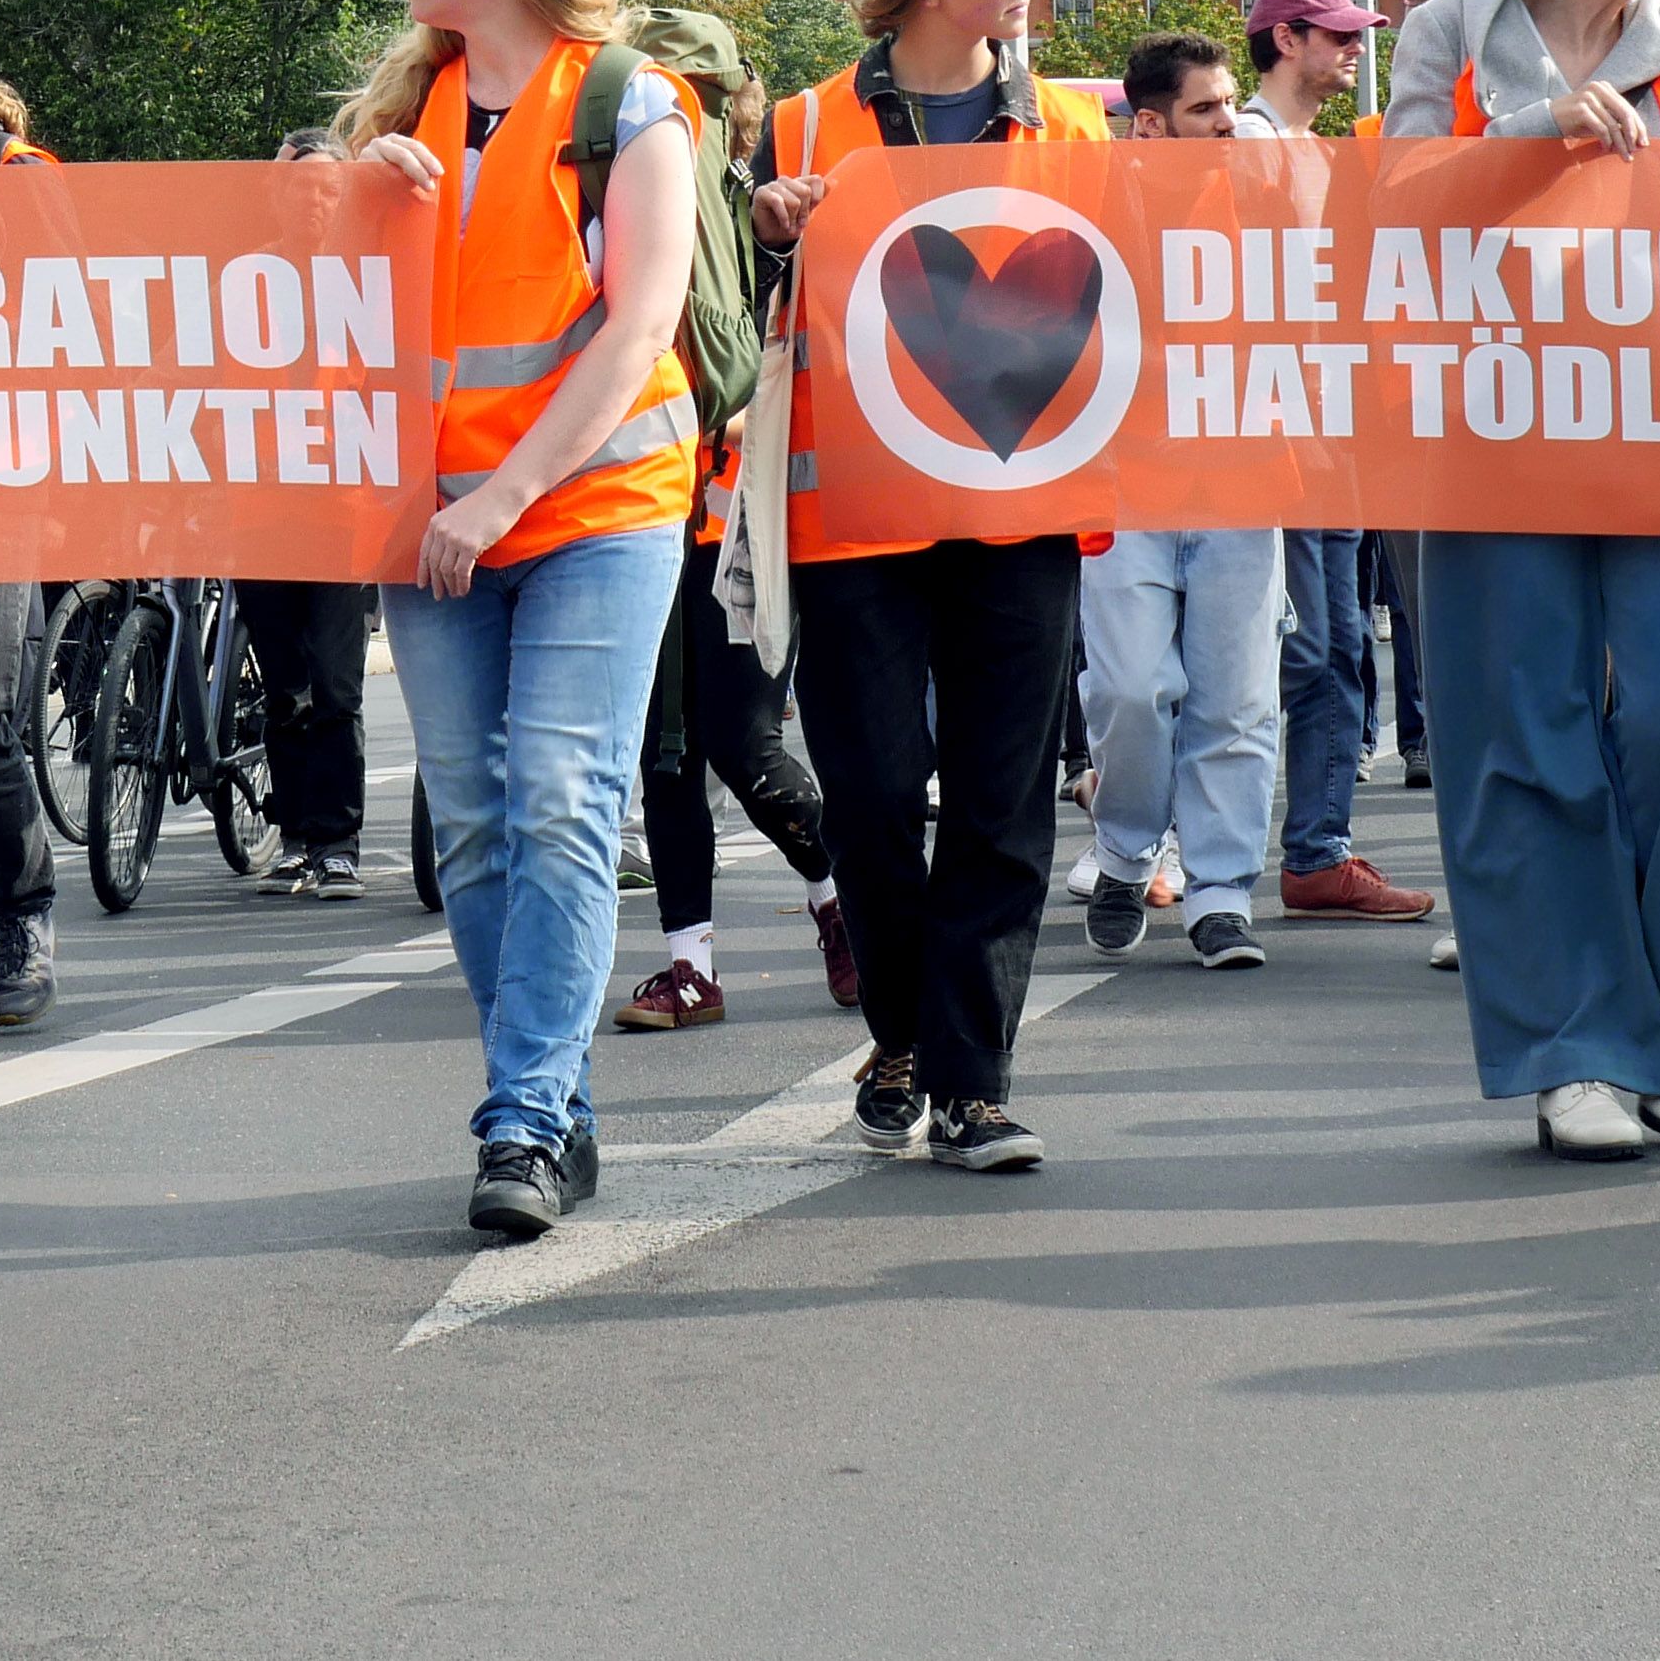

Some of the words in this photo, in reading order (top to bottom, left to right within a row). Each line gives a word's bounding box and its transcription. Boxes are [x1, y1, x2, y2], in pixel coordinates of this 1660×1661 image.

[1162, 227, 1337, 322] DIE
[1165, 344, 1368, 438] HAT
[679, 983, 702, 1008] N
